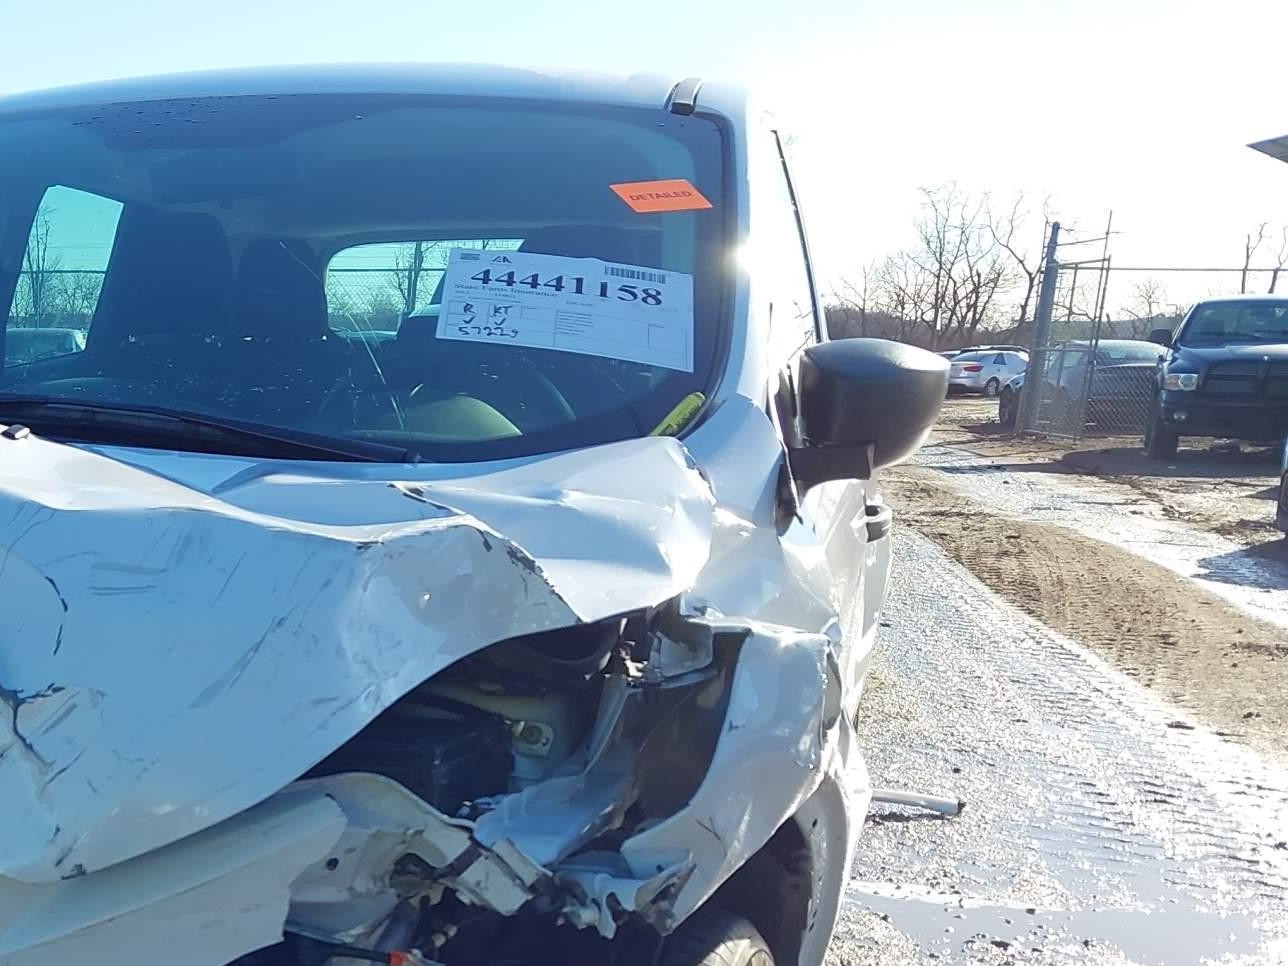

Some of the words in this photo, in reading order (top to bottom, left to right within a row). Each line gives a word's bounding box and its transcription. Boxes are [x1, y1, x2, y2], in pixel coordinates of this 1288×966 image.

[629, 190, 692, 201] DETAILED
[470, 268, 663, 306] 44441158
[463, 303, 475, 314] R
